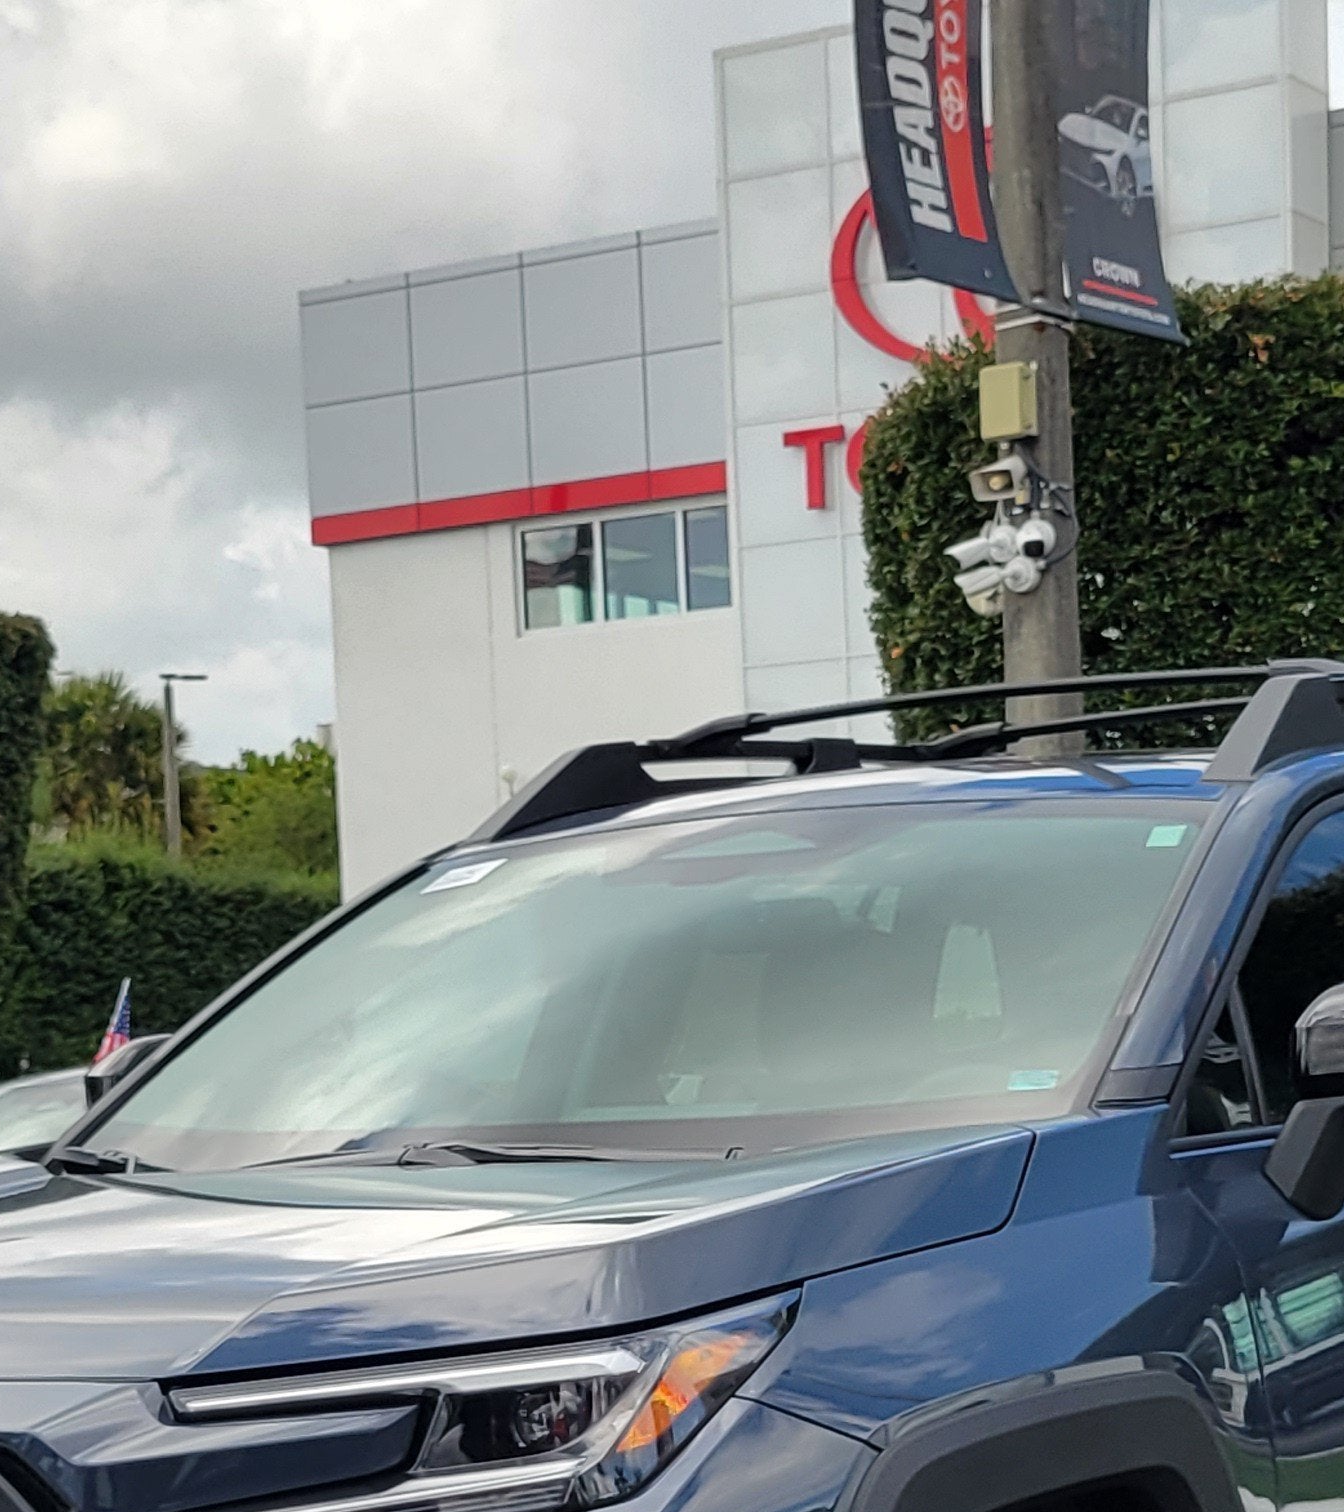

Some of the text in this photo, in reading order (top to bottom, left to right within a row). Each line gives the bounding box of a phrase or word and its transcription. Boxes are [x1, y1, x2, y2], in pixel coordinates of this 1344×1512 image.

[940, 0, 961, 69] TO
[882, 0, 955, 233] HEADQ
[782, 423, 866, 510] T
